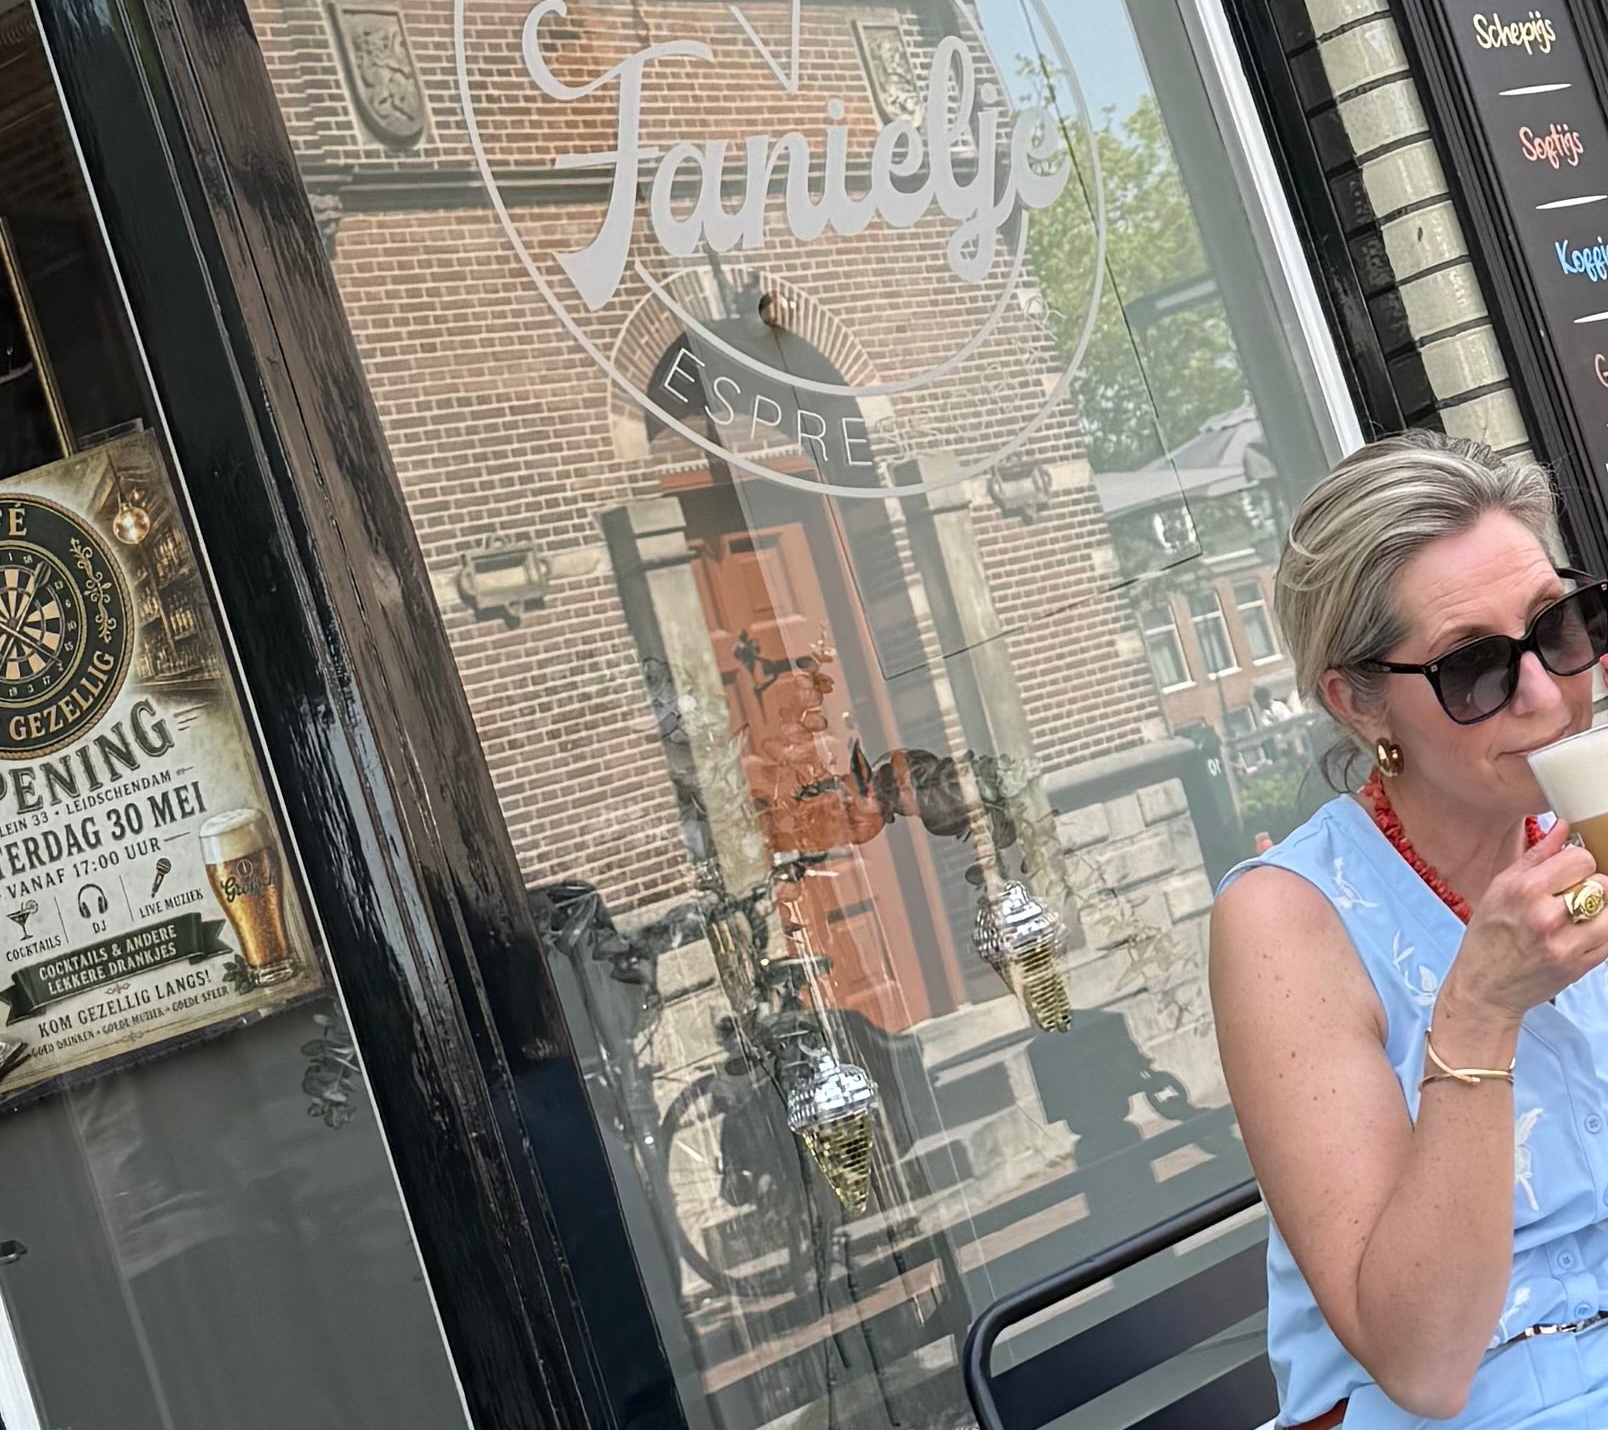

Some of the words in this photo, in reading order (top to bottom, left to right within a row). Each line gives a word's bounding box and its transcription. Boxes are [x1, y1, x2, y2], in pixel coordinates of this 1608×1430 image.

[1472, 10, 1557, 55] Schepijs
[1518, 123, 1584, 169] Softijs
[0, 502, 27, 536] É
[9, 650, 115, 741] GEZELLIG
[0, 698, 175, 816] ENING
[32, 811, 49, 827] 33
[65, 770, 172, 816] LEIDSCHENDAM
[106, 802, 144, 841] 30
[147, 781, 208, 828] MEI
[6, 868, 65, 899] VANAF
[73, 850, 120, 878] 17:00
[124, 837, 161, 860] UUR
[92, 920, 107, 934] DJ
[139, 901, 163, 919] LIVE
[5, 935, 62, 963] COCKTAILS
[39, 948, 108, 981] COCKTAILS
[111, 942, 122, 957] &
[126, 924, 177, 952] ANDERE
[48, 967, 106, 995] LEKKERE
[108, 943, 177, 978] DRANKJES
[38, 1014, 73, 1038] KOM
[78, 990, 151, 1025] GEZELLIG
[156, 969, 212, 1000] LANGS!
